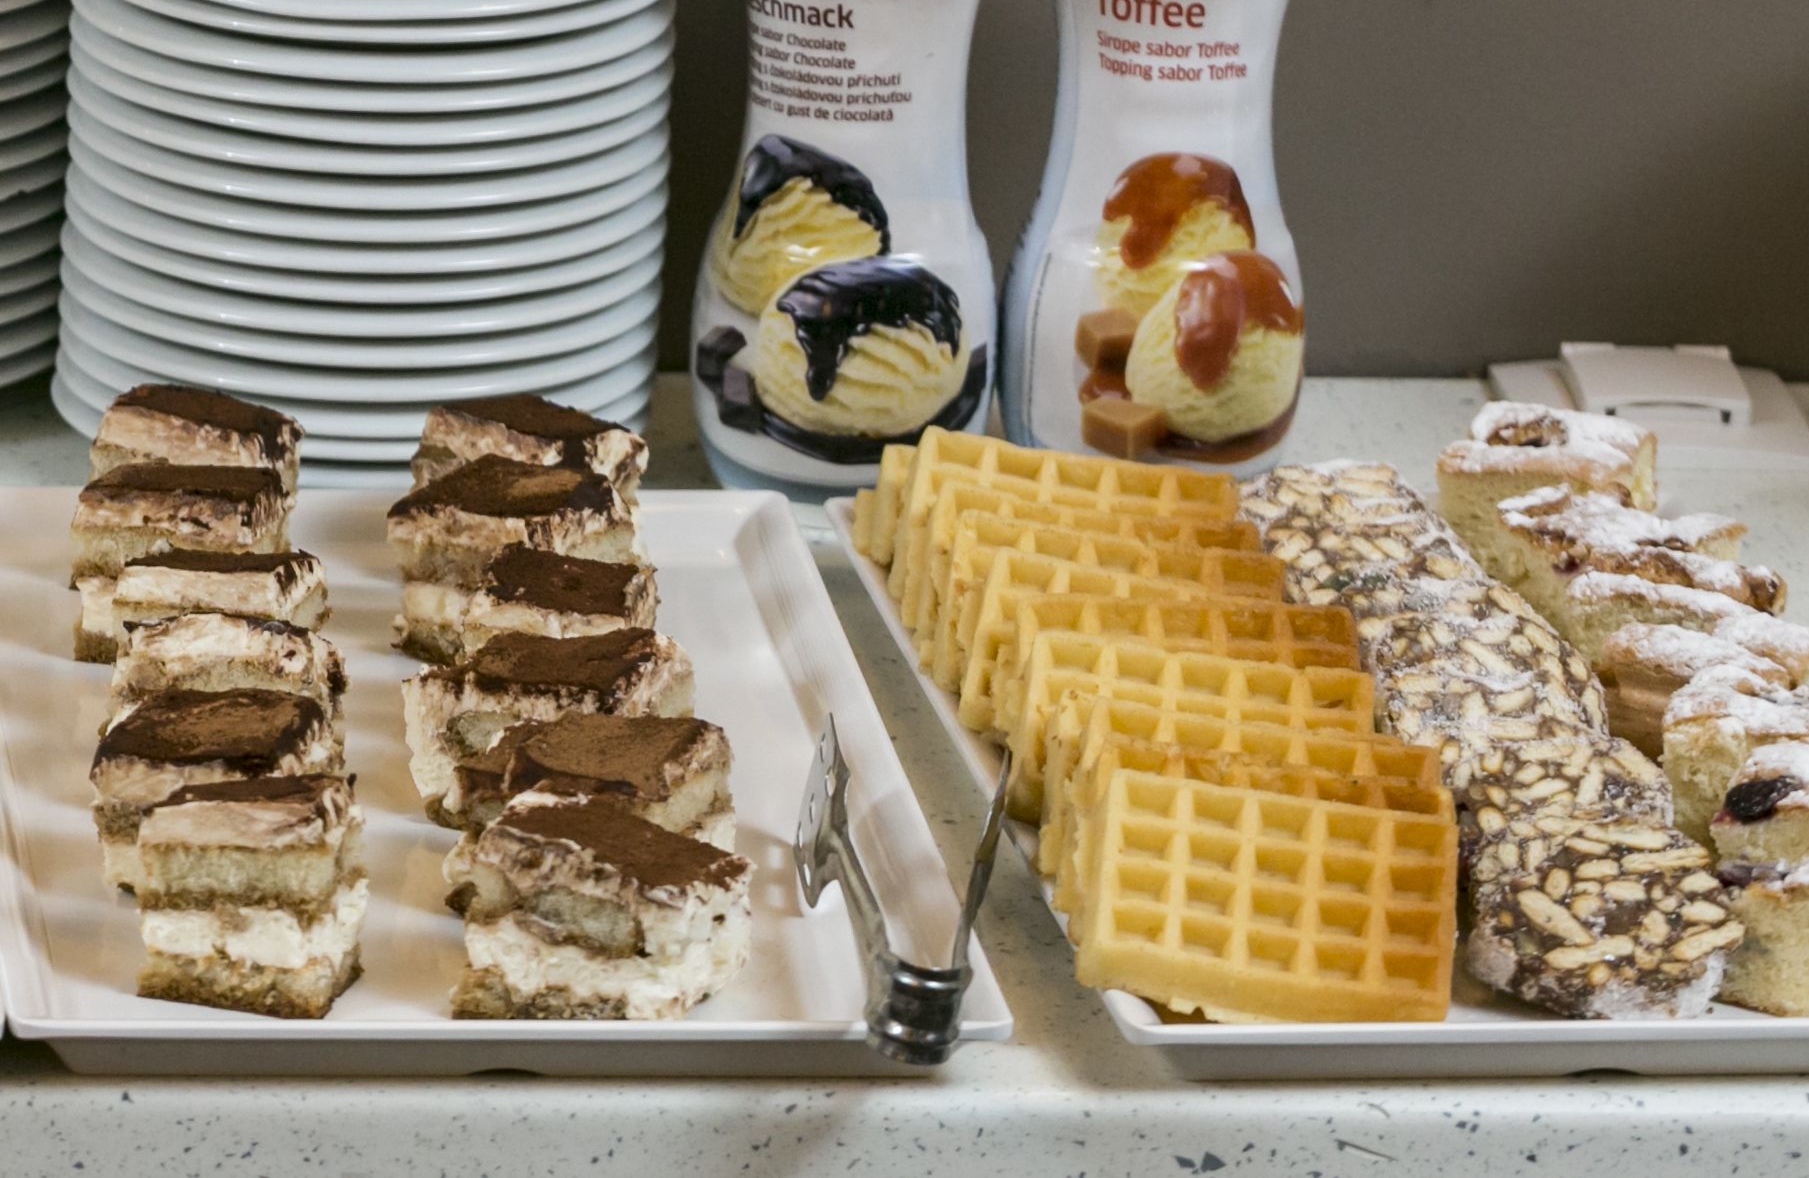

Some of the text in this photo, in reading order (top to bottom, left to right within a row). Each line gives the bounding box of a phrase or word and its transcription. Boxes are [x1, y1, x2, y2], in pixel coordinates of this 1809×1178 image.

[786, 33, 847, 52] Chocolate
[1097, 30, 1240, 58] Sirope sabor Toffee
[793, 52, 856, 70] Chocolate
[1099, 52, 1247, 82] Topping sabor Toffee
[786, 103, 810, 117] gust
[813, 106, 830, 120] de
